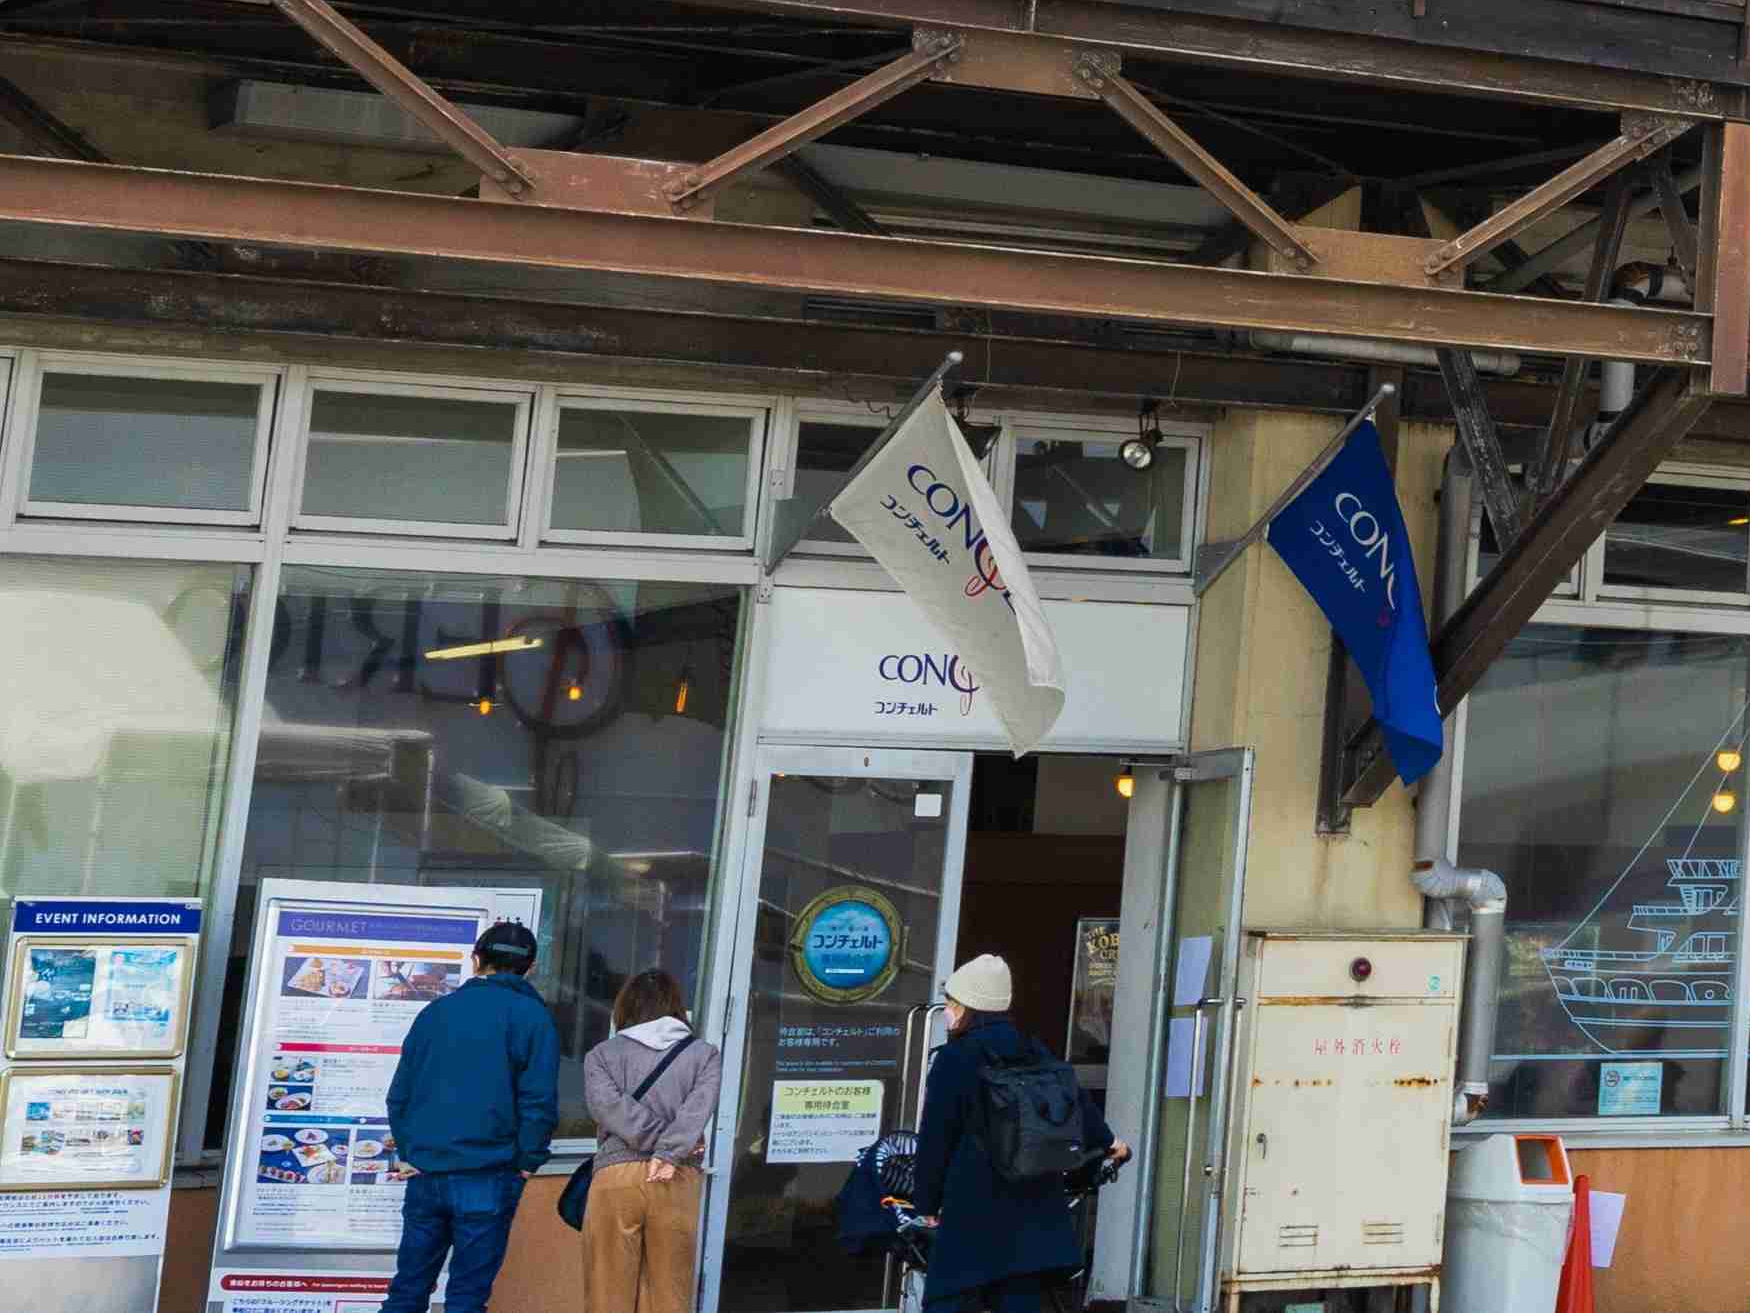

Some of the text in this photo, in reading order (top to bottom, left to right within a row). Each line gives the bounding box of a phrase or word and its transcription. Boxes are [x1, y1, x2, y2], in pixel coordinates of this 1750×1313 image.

[880, 493, 951, 565] コンチェルト
[1309, 519, 1366, 593] コンチェルト
[873, 701, 939, 716] コンチェルト
[35, 912, 181, 926] EVENT INFORMATION
[289, 917, 369, 934] GOURMET
[812, 934, 884, 950] コンチェルト
[1313, 1038, 1402, 1056] 屋外消火栓
[783, 1086, 872, 1097] コンチェルトのお客様
